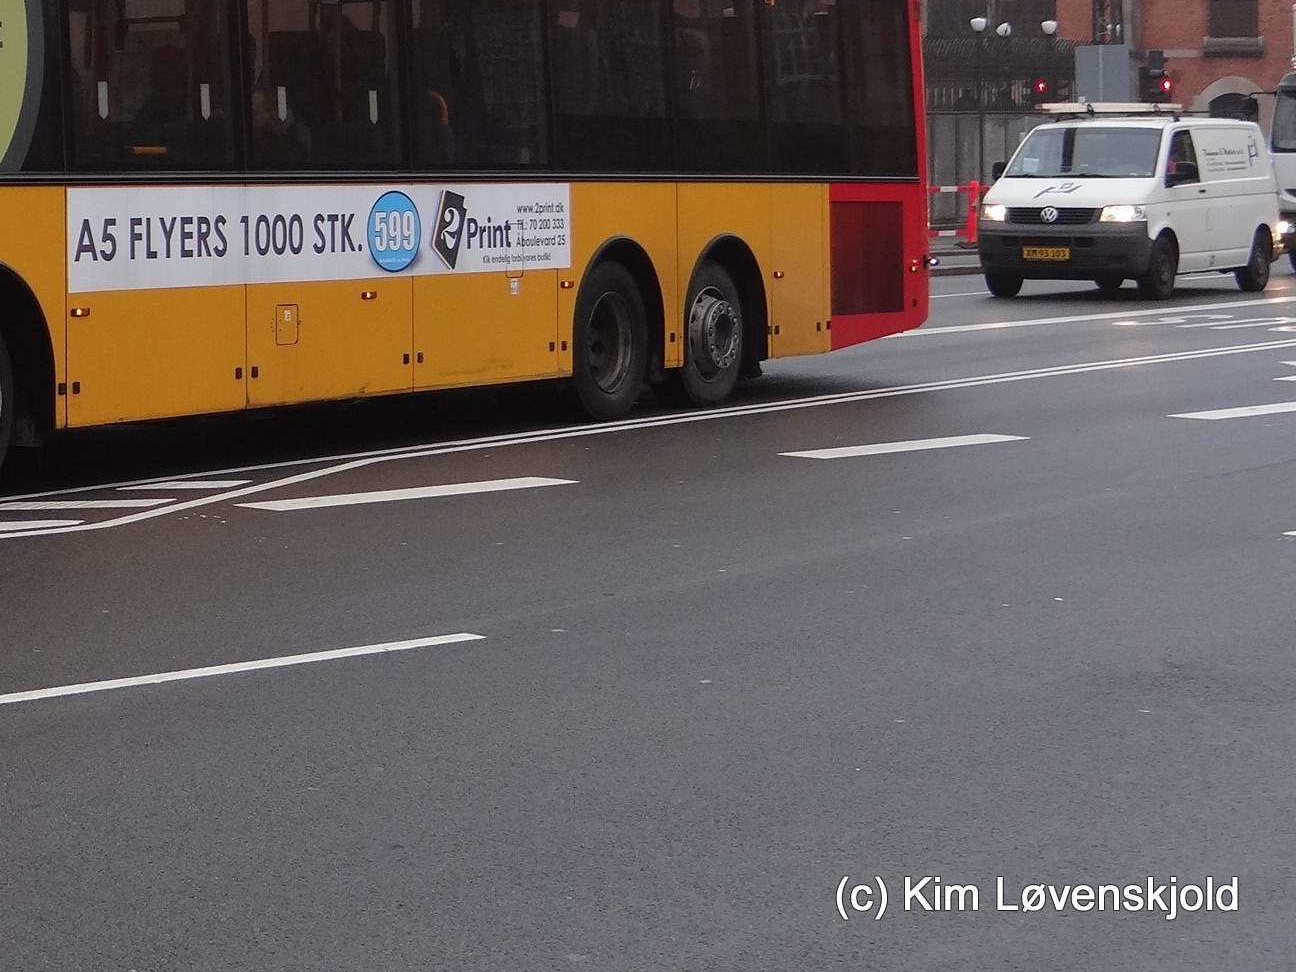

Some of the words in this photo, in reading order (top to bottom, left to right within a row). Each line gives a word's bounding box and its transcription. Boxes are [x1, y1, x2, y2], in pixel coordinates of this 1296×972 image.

[516, 202, 565, 216] www.2print.dk
[375, 210, 416, 252] 599
[529, 218, 538, 230] 70
[539, 218, 551, 230] 200
[552, 218, 564, 229] 333
[74, 218, 117, 262] A5
[130, 214, 228, 260] FLYERS
[239, 213, 304, 256] 1000
[312, 213, 364, 255] STK.
[516, 233, 556, 247] Åboulevard
[557, 234, 566, 246] 25
[1051, 249, 1067, 257] 103
